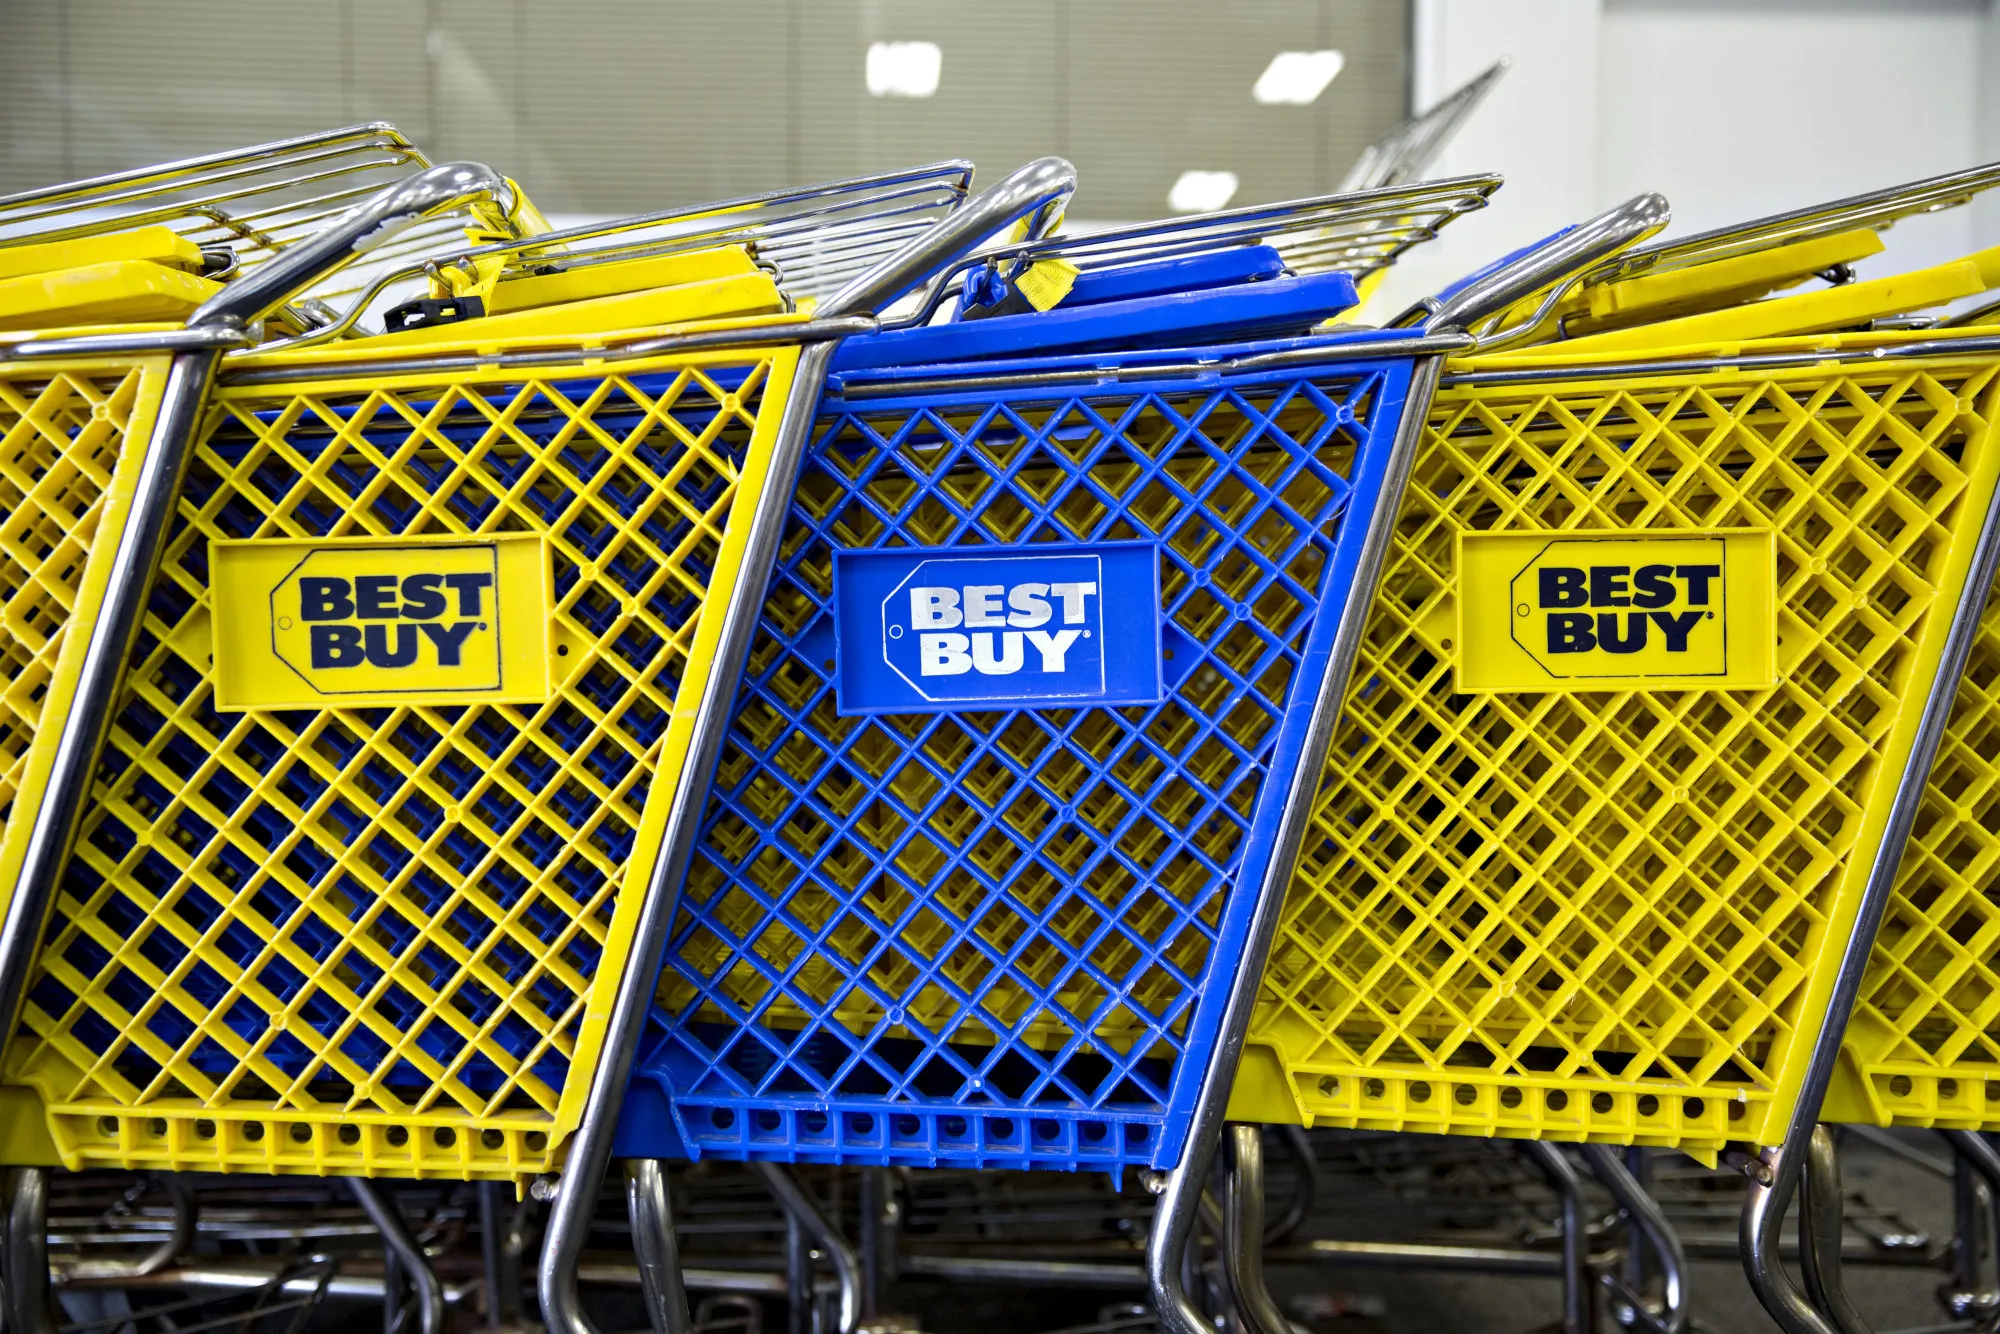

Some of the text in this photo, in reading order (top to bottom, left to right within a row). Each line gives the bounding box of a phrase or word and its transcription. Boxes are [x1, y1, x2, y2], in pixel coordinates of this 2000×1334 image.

[300, 572, 492, 621] BEST
[910, 582, 1097, 630] BEST
[1538, 564, 1720, 608] BEST
[310, 622, 479, 669] BUY
[920, 629, 1083, 676] BUY
[1547, 611, 1706, 654] BUY
